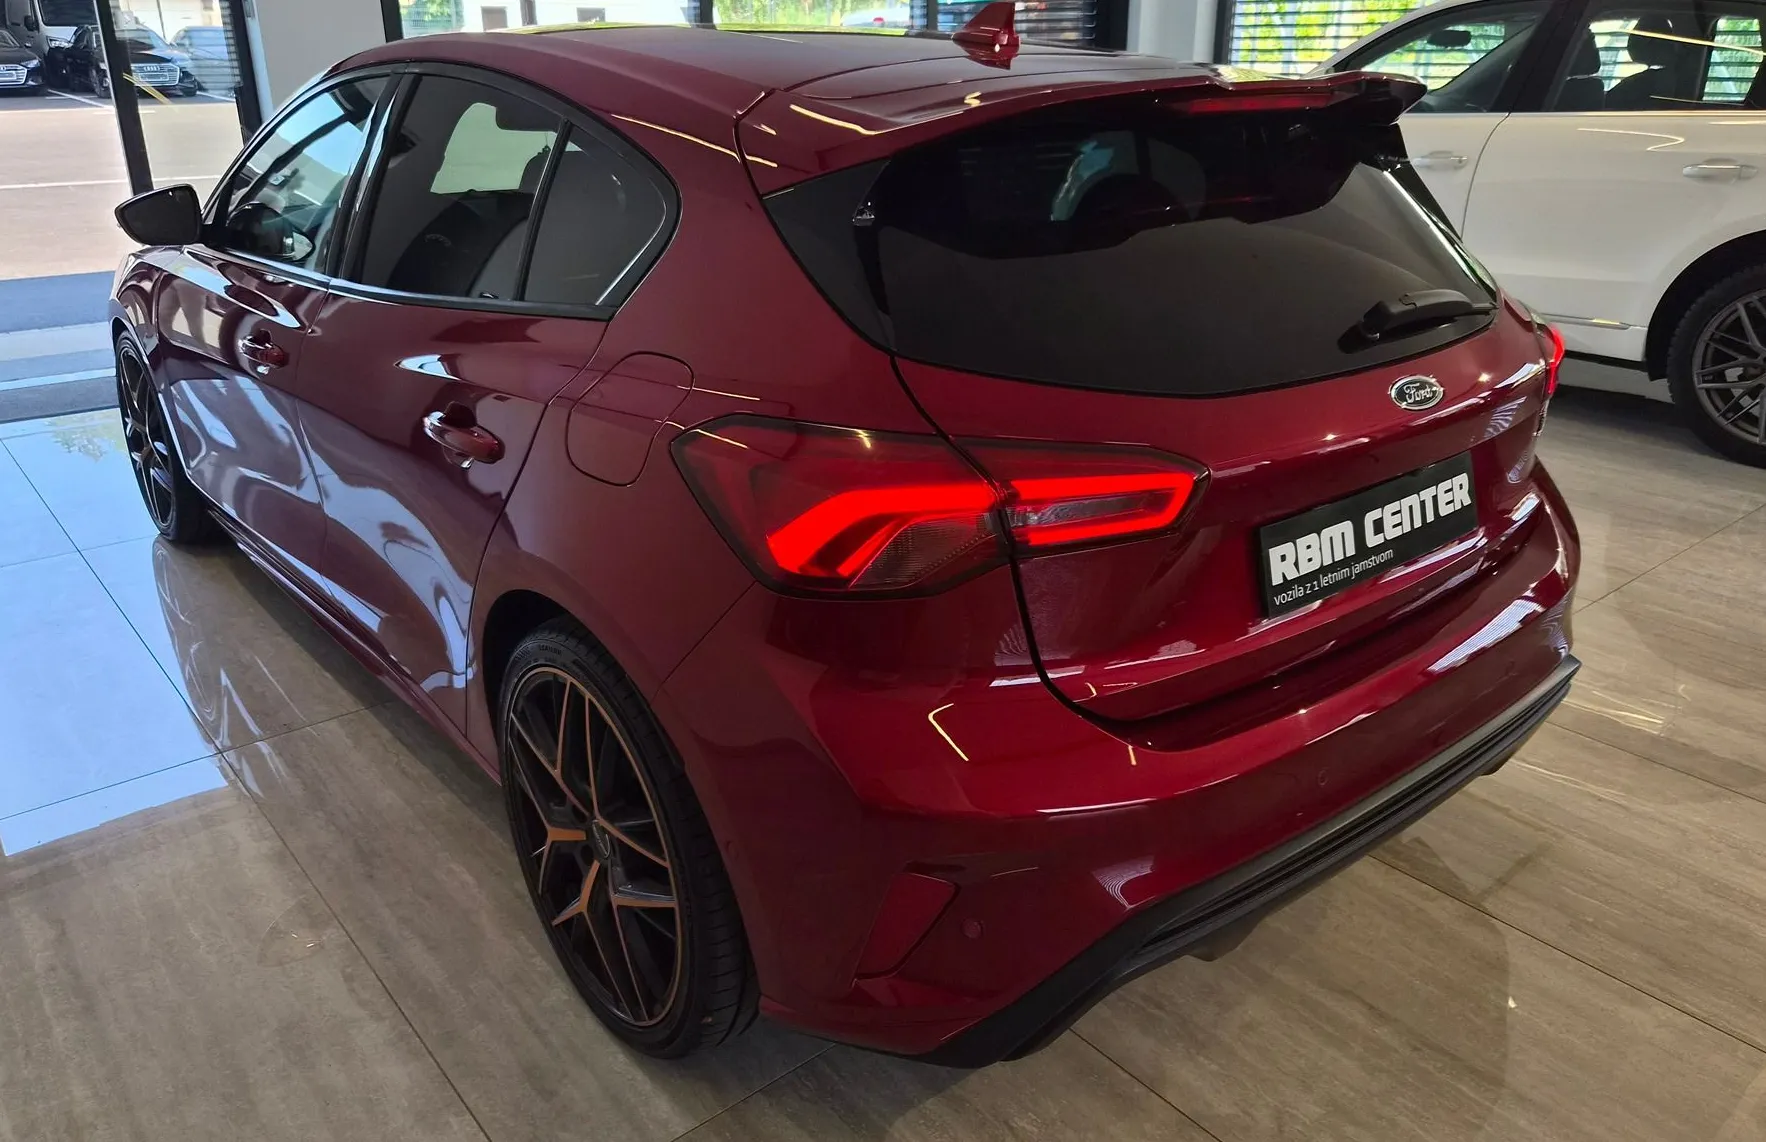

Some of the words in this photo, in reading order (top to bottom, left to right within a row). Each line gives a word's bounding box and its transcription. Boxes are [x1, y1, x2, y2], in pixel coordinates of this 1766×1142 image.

[1269, 520, 1356, 586] RBM
[1364, 472, 1472, 548] CENTER
[1274, 584, 1304, 606] vozila
[1306, 583, 1312, 594] z
[1312, 580, 1320, 591] 1
[1320, 567, 1350, 588] letnim
[1351, 549, 1394, 580] jamstvom
